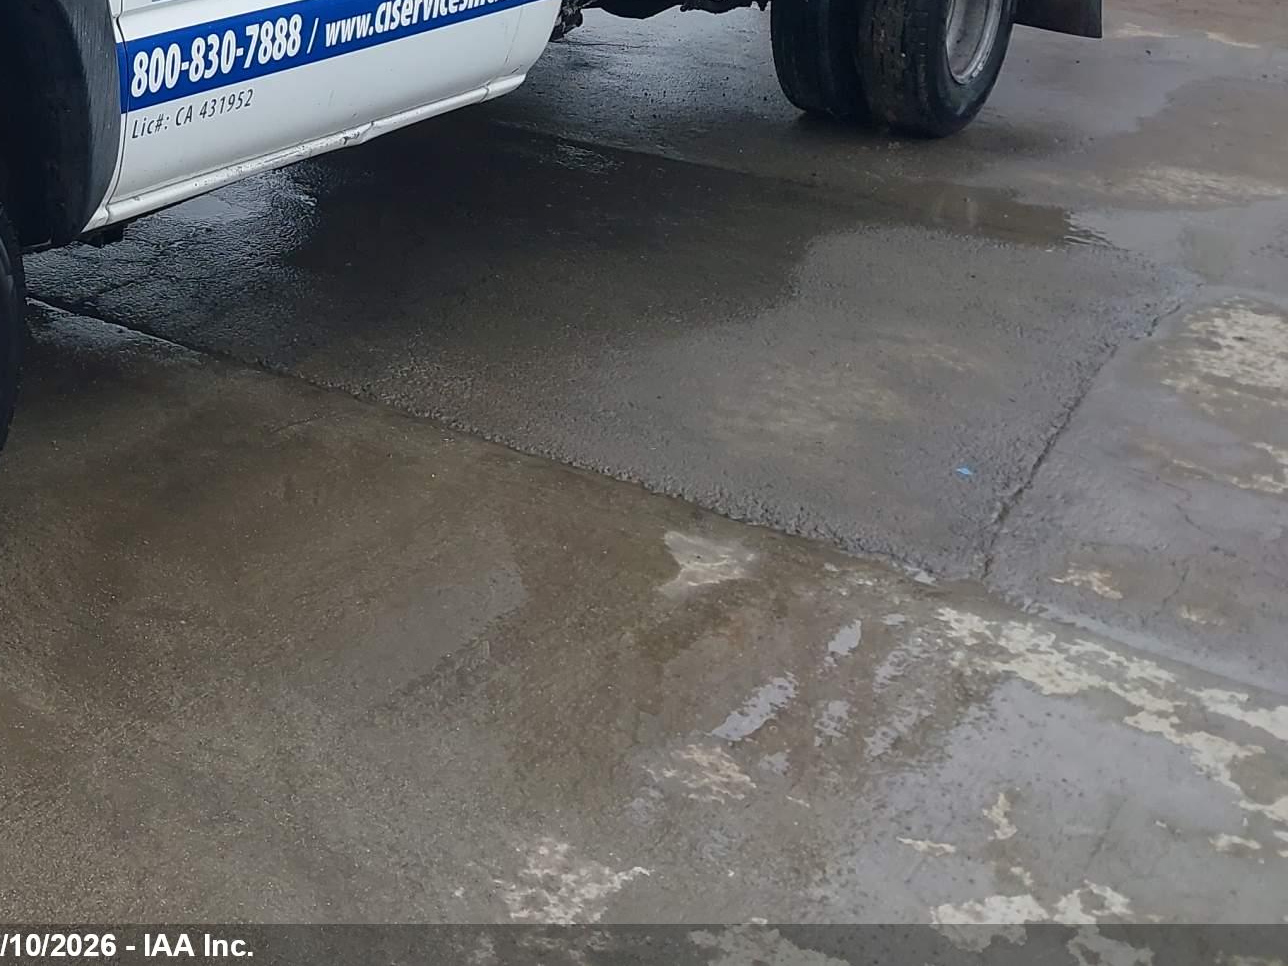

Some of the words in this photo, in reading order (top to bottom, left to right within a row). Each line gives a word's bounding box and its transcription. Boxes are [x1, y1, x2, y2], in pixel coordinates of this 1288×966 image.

[131, 14, 302, 97] 800-830-7888
[132, 114, 170, 139] Lic#:
[176, 105, 193, 127] CA
[200, 89, 254, 119] 431952
